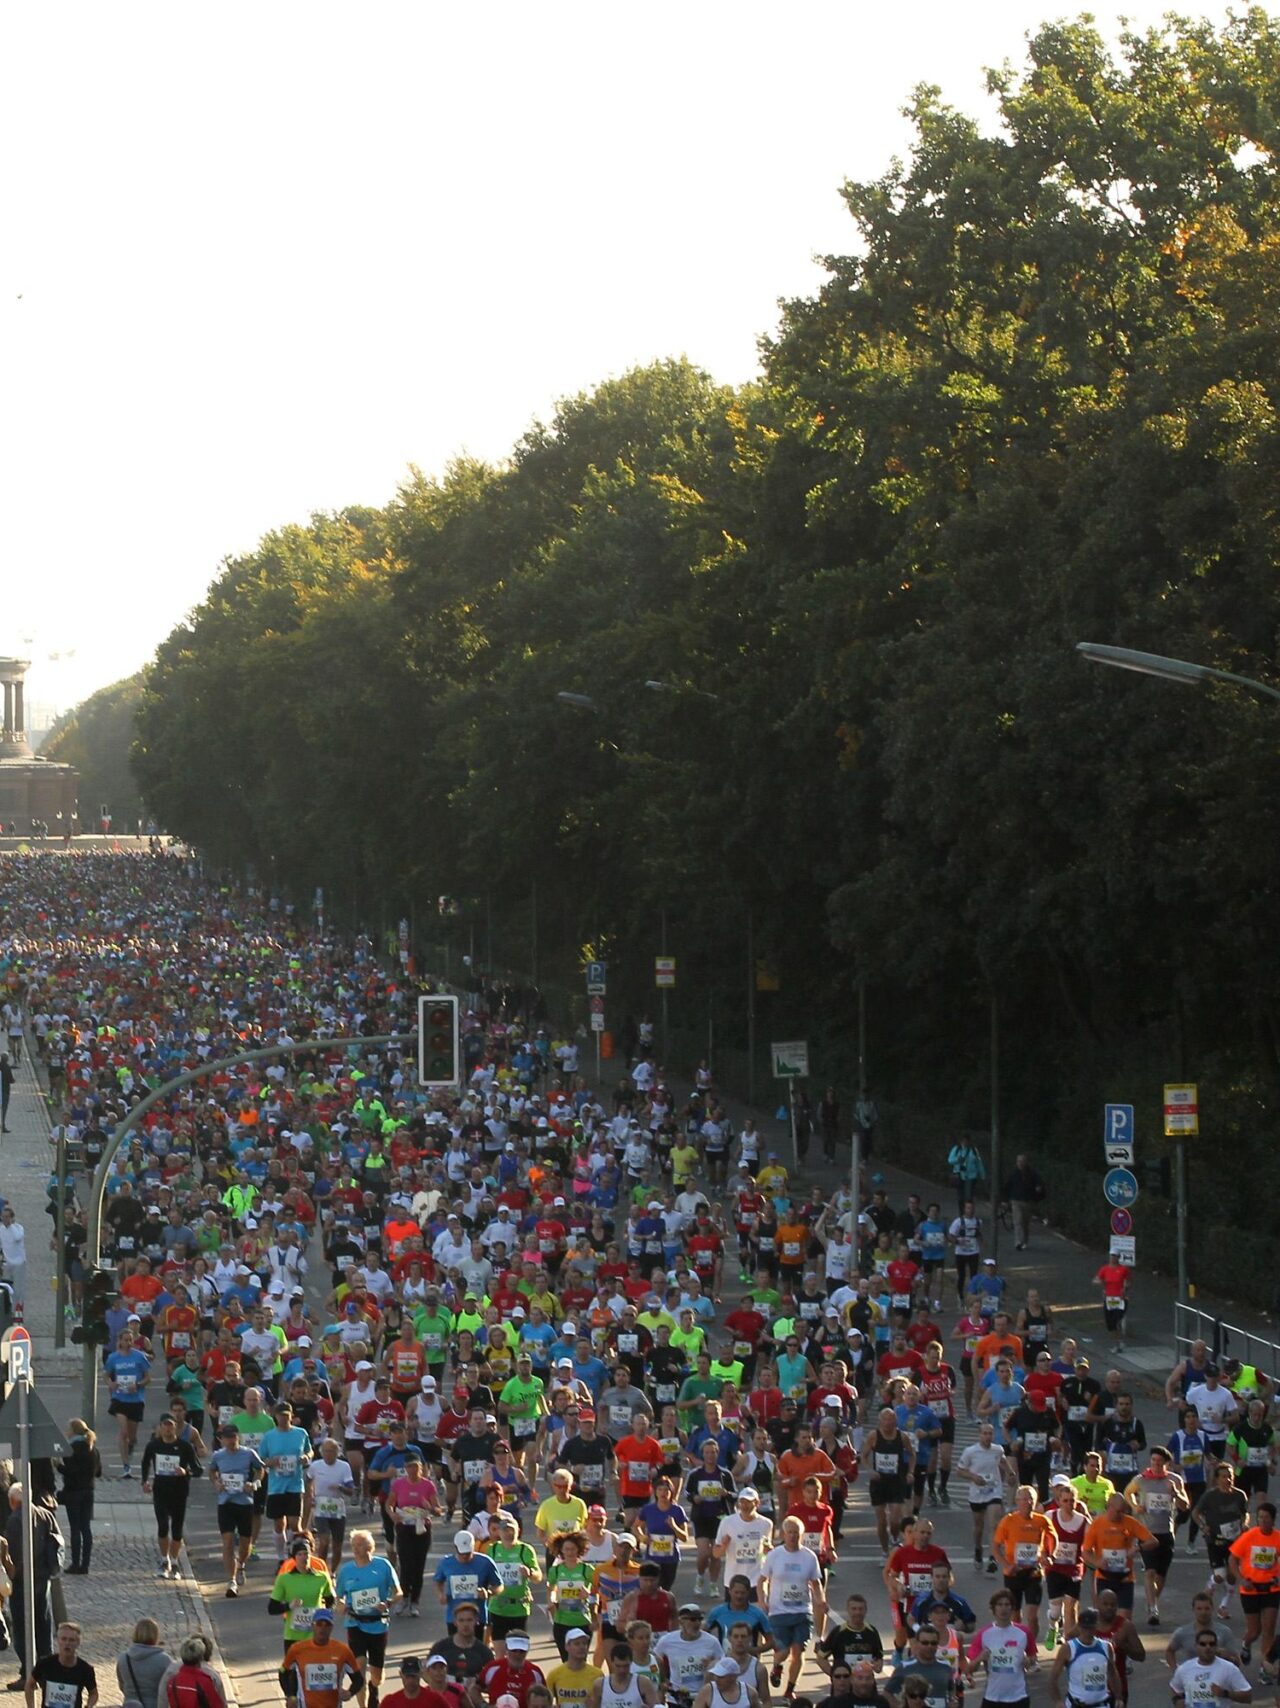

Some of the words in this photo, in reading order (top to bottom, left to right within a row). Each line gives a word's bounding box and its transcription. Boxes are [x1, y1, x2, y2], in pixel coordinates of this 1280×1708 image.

[590, 964, 602, 982] P
[1111, 1109, 1128, 1139] P
[12, 1346, 24, 1377] P
